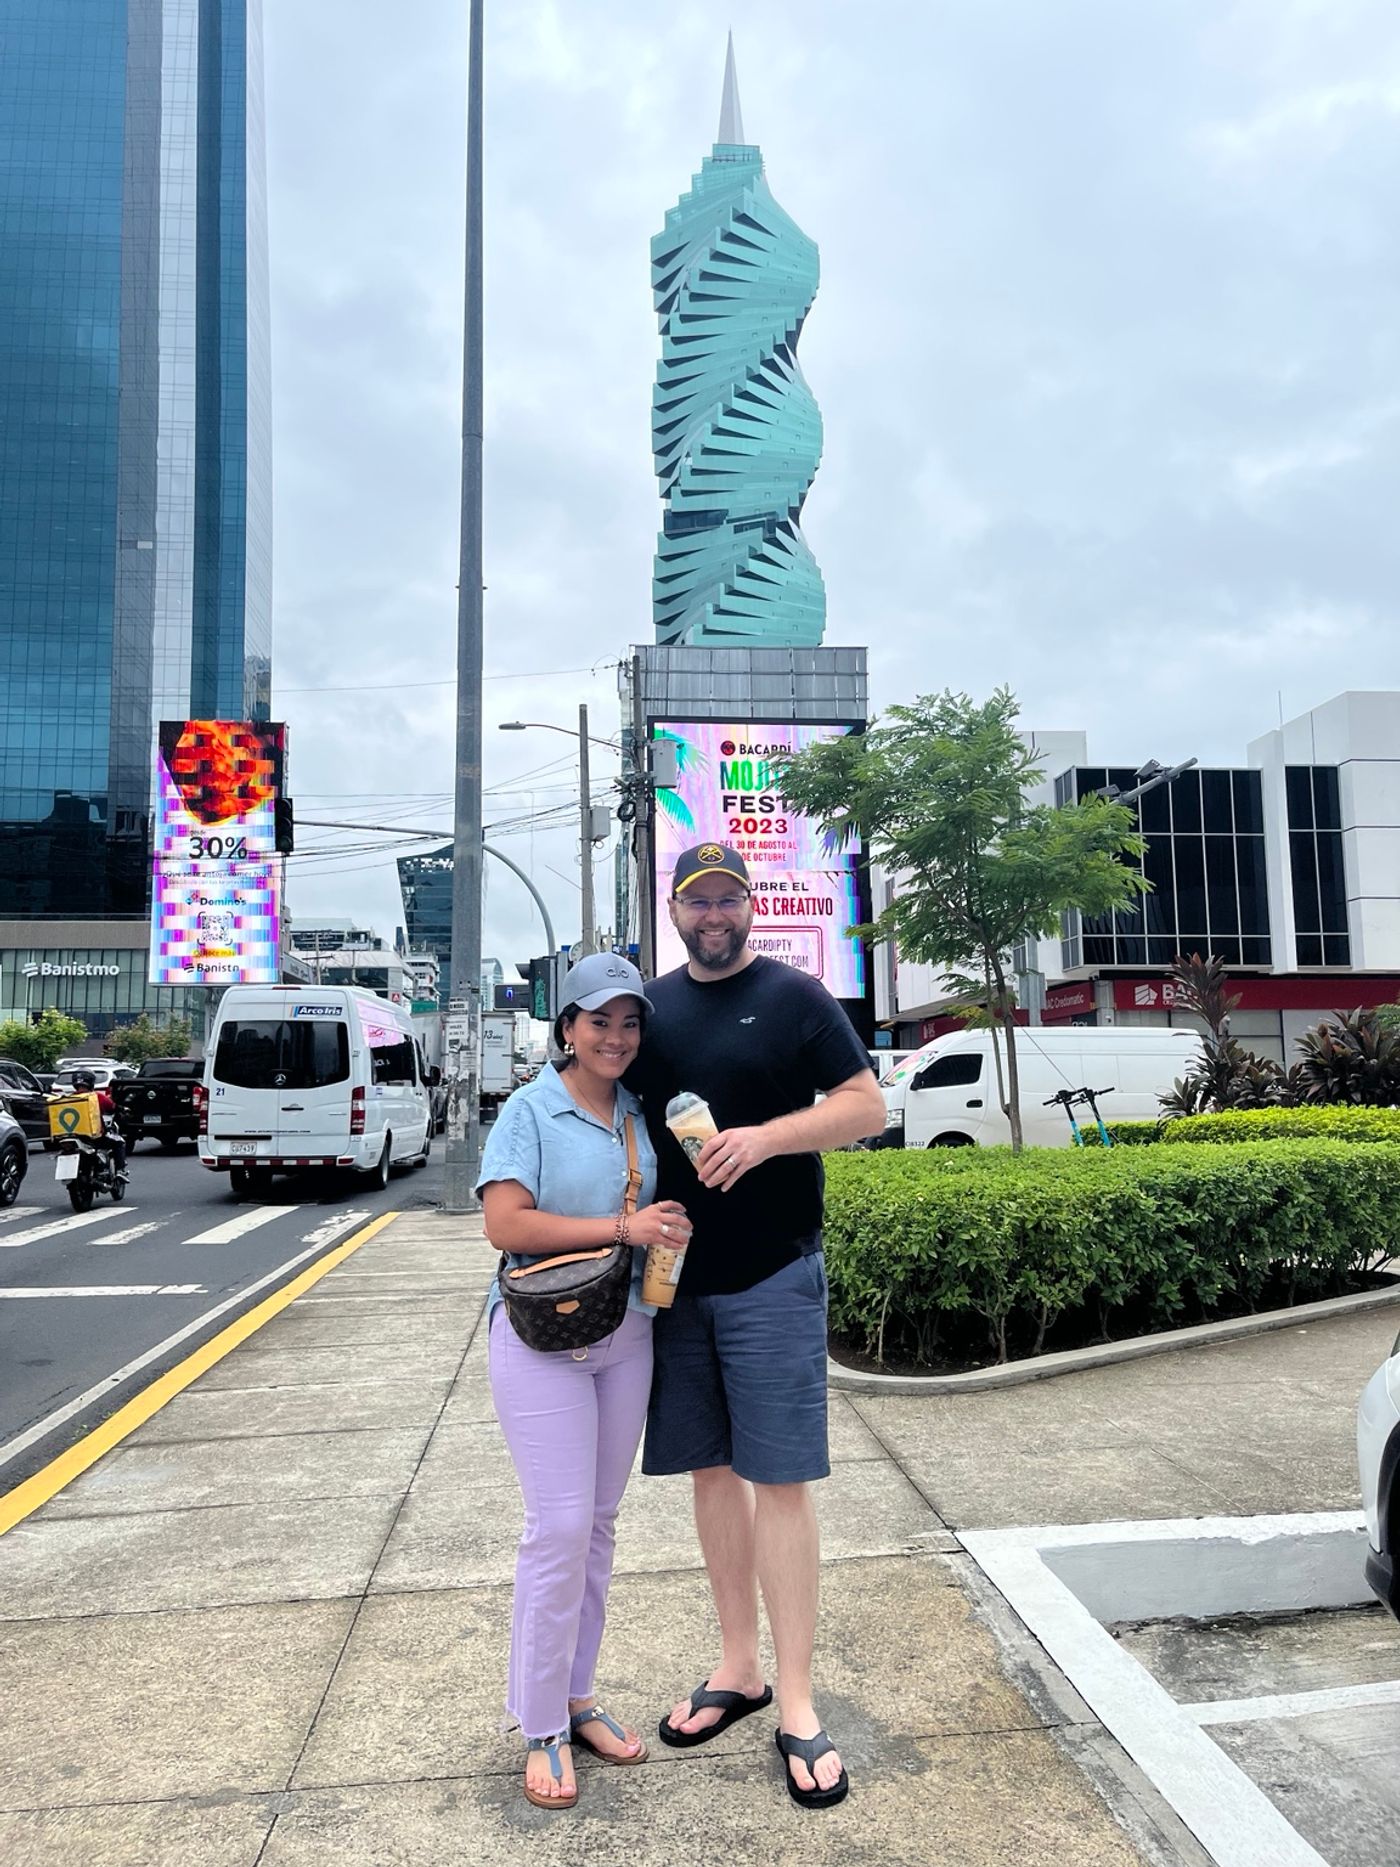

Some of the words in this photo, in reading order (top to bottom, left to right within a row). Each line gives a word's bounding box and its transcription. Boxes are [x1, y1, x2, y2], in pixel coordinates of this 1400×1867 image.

[720, 760, 792, 792] MOJI
[722, 795, 790, 813] FEST
[729, 818, 788, 834] 2023
[189, 836, 248, 860] 30%
[747, 841, 757, 850] DE
[758, 840, 787, 850] AGOSTO
[788, 841, 797, 850] AL
[753, 852, 787, 862] OCTUBRE
[750, 882, 787, 891] UBRE
[792, 882, 810, 891] EL
[200, 896, 247, 907] Domino's
[773, 897, 833, 916] CREATIVO
[747, 939, 793, 952] ACARDIPTY
[41, 961, 120, 976] Banistmo
[1162, 983, 1201, 1000] BA
[300, 1006, 323, 1014] Arco
[324, 1007, 341, 1015] Iris
[216, 1088, 225, 1096] 21
